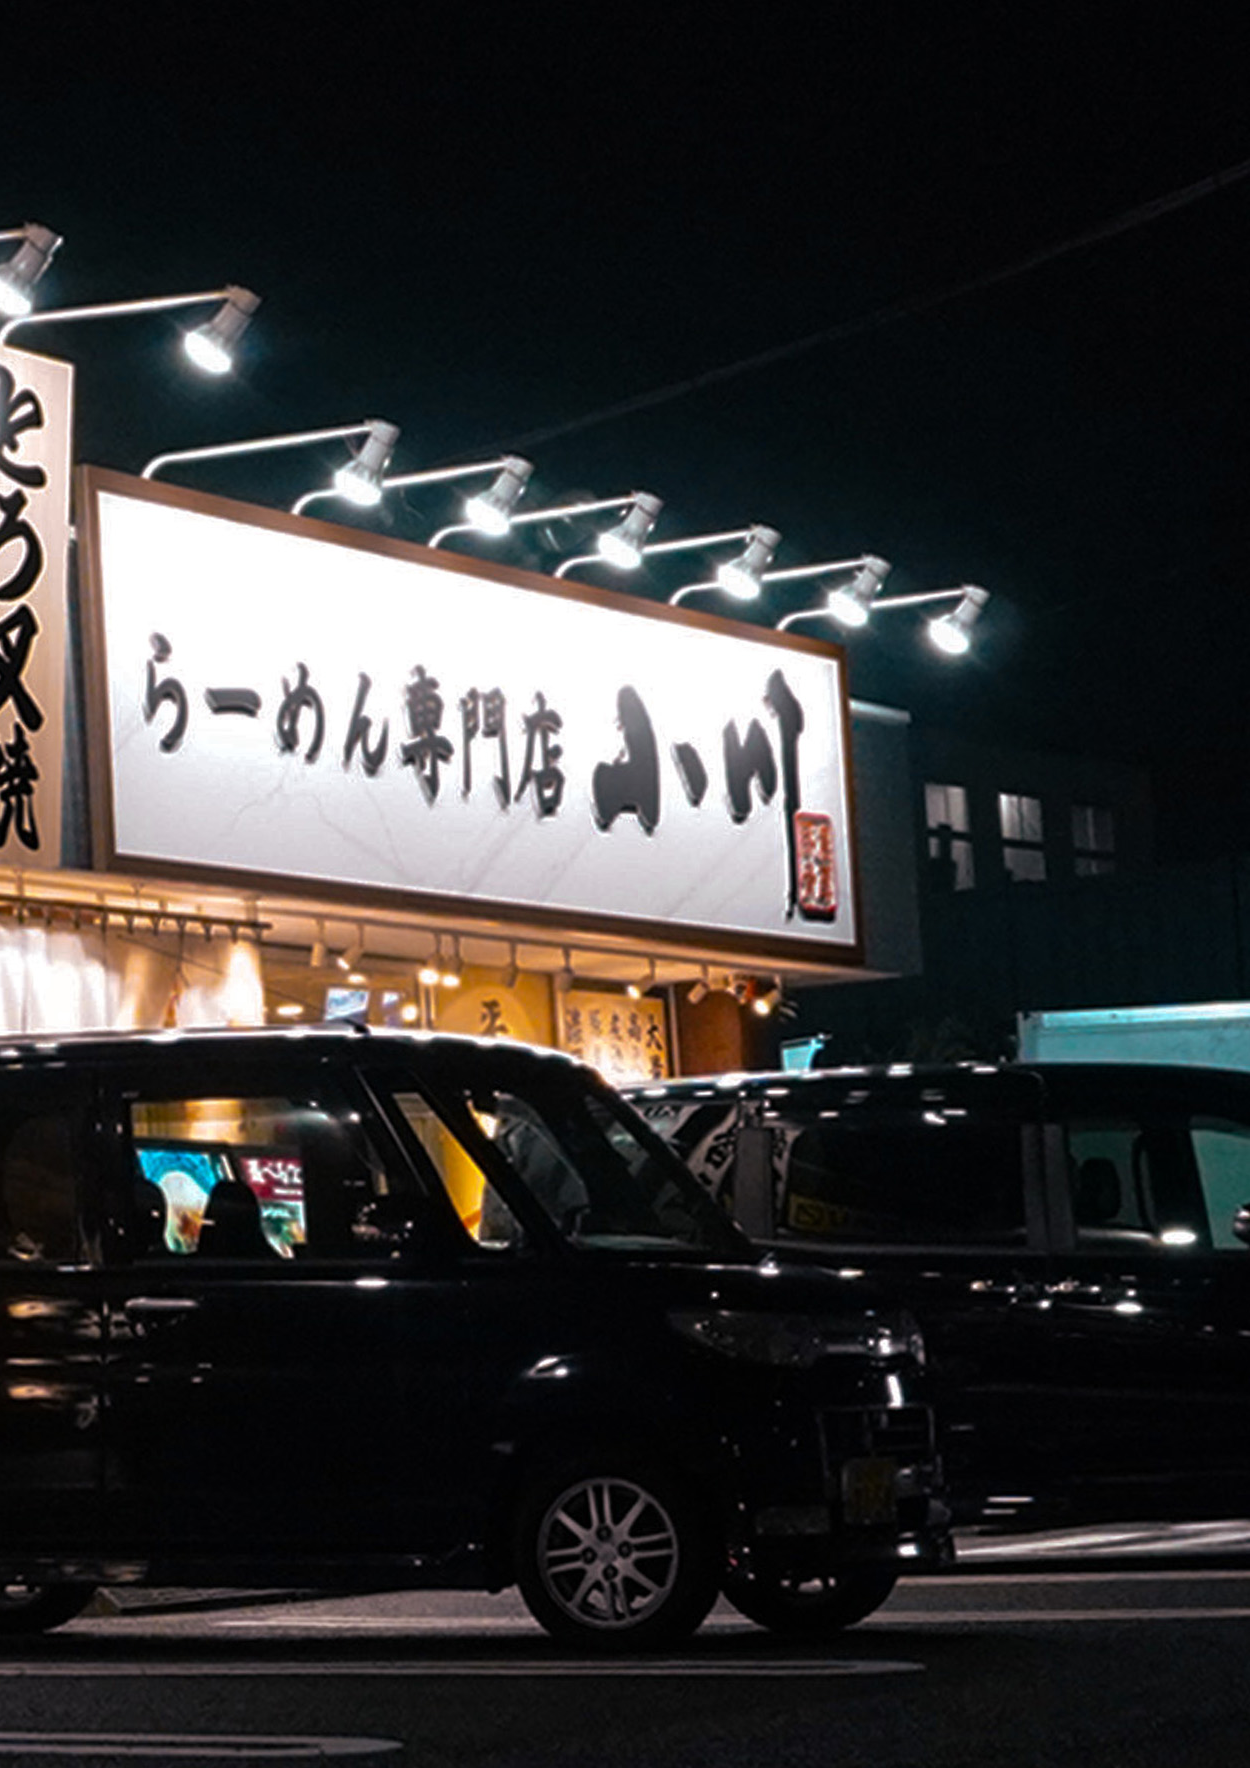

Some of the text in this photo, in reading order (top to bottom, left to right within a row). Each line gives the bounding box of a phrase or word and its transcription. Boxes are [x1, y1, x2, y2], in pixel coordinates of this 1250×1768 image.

[141, 632, 569, 819] らーめん専門店
[591, 668, 806, 922] 小川
